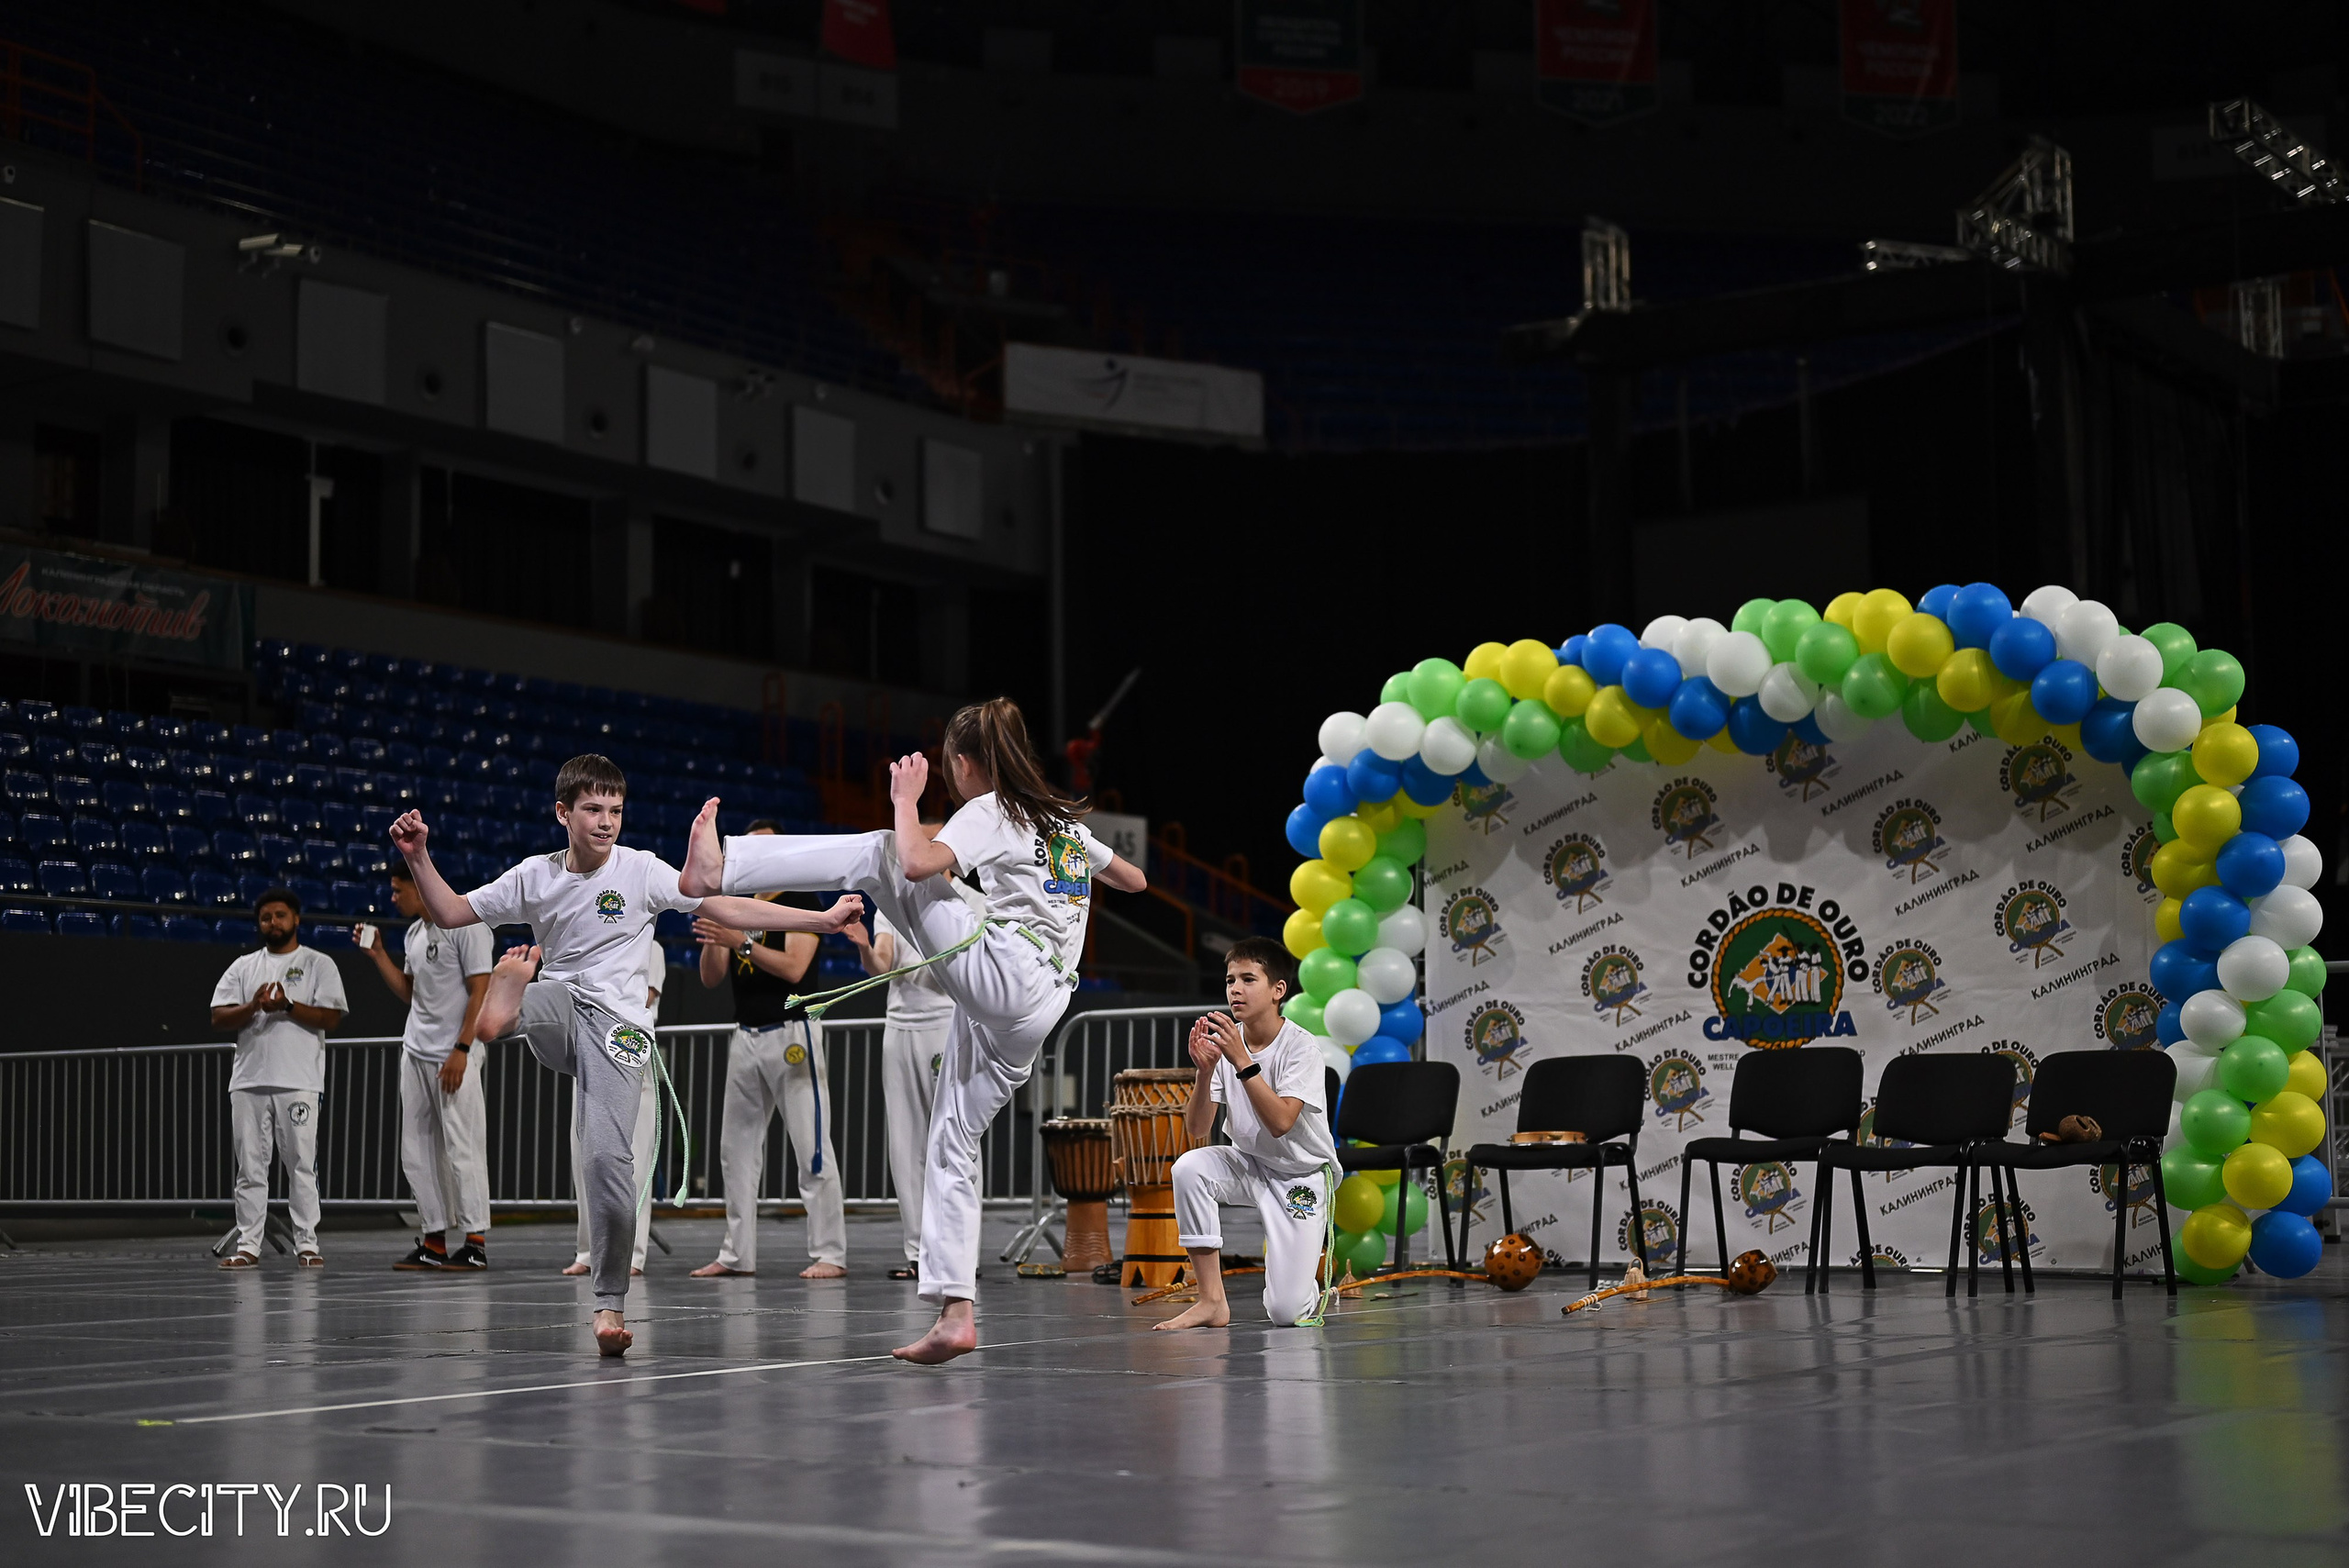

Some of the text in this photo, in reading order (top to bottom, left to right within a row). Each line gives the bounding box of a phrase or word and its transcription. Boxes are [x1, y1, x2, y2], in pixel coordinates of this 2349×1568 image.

[1273, 76, 1330, 100] 2019
[2043, 735, 2072, 762] OURO
[1523, 792, 1598, 836] КАЛИНИНГРАД
[1652, 784, 1672, 830] CORDÃO
[1674, 777, 1688, 787] DE
[1691, 778, 1718, 803] OURO
[1821, 769, 1904, 817] КАЛИНИНГРАД
[1872, 798, 1942, 853] CORDÃO DE OURO
[2025, 805, 2115, 853] КАЛИНИНГРАД
[1543, 833, 1606, 885] CORDÃO DE OURO
[1680, 842, 1760, 888] КАЛИНИНГРАД
[2121, 827, 2145, 877] CORDÃO
[595, 889, 609, 906] CORDÃO
[618, 893, 627, 907] OURO
[1440, 886, 1499, 938] CORDÃO DE OURO
[1895, 869, 1979, 916] КАЛИНИНГРАД
[1994, 880, 2066, 937] CORDÃO DE OURO
[1549, 912, 1624, 956] КАЛИНИНГРАД
[1688, 882, 1869, 988] CORDÃO DE OURO
[1581, 944, 1643, 996] CORDÃO DE OURO
[1872, 939, 1942, 994] CORDÃO DE OURO
[2031, 953, 2121, 1000] КАЛИНИНГРАД
[1464, 999, 1525, 1051] CORDÃO DE OURO
[1615, 1010, 1692, 1052] КАЛИНИНГРАД
[1703, 1011, 1857, 1041] CAPOEIRA
[2094, 988, 2118, 1040] CORDÃO
[2119, 982, 2135, 993] DE
[1664, 1048, 1677, 1059] DE
[1680, 1050, 1707, 1076] OURO
[1708, 1053, 1740, 1062] MESTRE
[1712, 1062, 1735, 1071] WELL
[1992, 1040, 2039, 1068] DE OURO
[1449, 1149, 1462, 1160] DE
